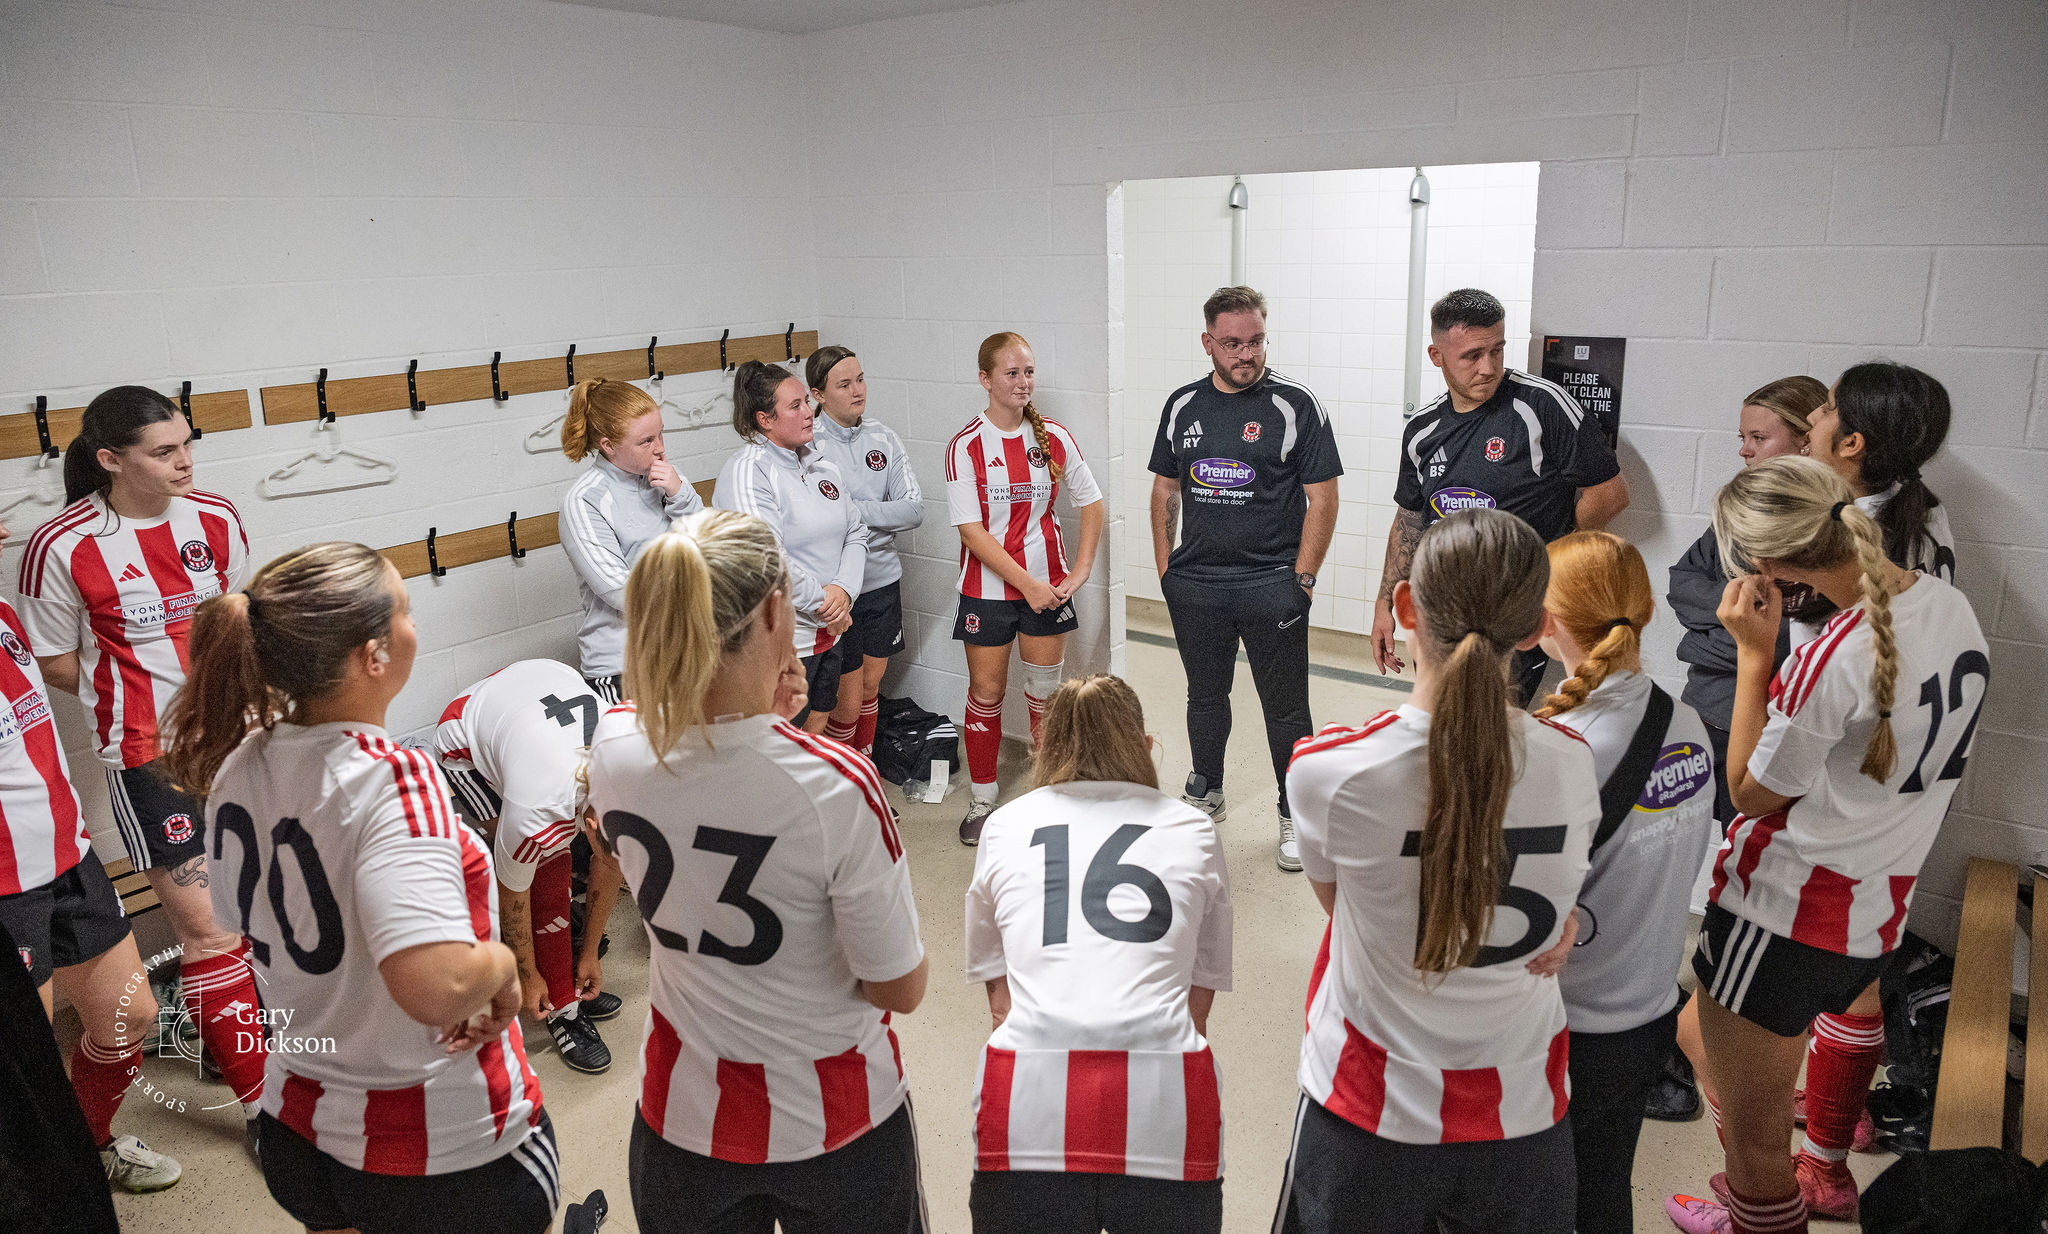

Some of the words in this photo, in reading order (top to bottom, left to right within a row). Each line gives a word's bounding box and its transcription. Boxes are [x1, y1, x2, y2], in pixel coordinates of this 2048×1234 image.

[1563, 372, 1600, 385] PLEASE
[1579, 386, 1611, 399] CLEAN
[1592, 400, 1612, 412] THE
[1183, 436, 1202, 449] RY
[1199, 463, 1252, 480] Premier
[1429, 465, 1446, 477] BS
[993, 492, 1045, 501] MANAGEMENT
[1218, 489, 1255, 499] shopper
[1439, 494, 1491, 510] Premier
[122, 603, 165, 618] LYONS
[139, 606, 196, 625] MANAGE
[539, 694, 599, 750] 4
[1898, 650, 1990, 794] 12
[213, 802, 345, 975] 20
[602, 810, 784, 966] 23
[1029, 823, 1173, 947] 16
